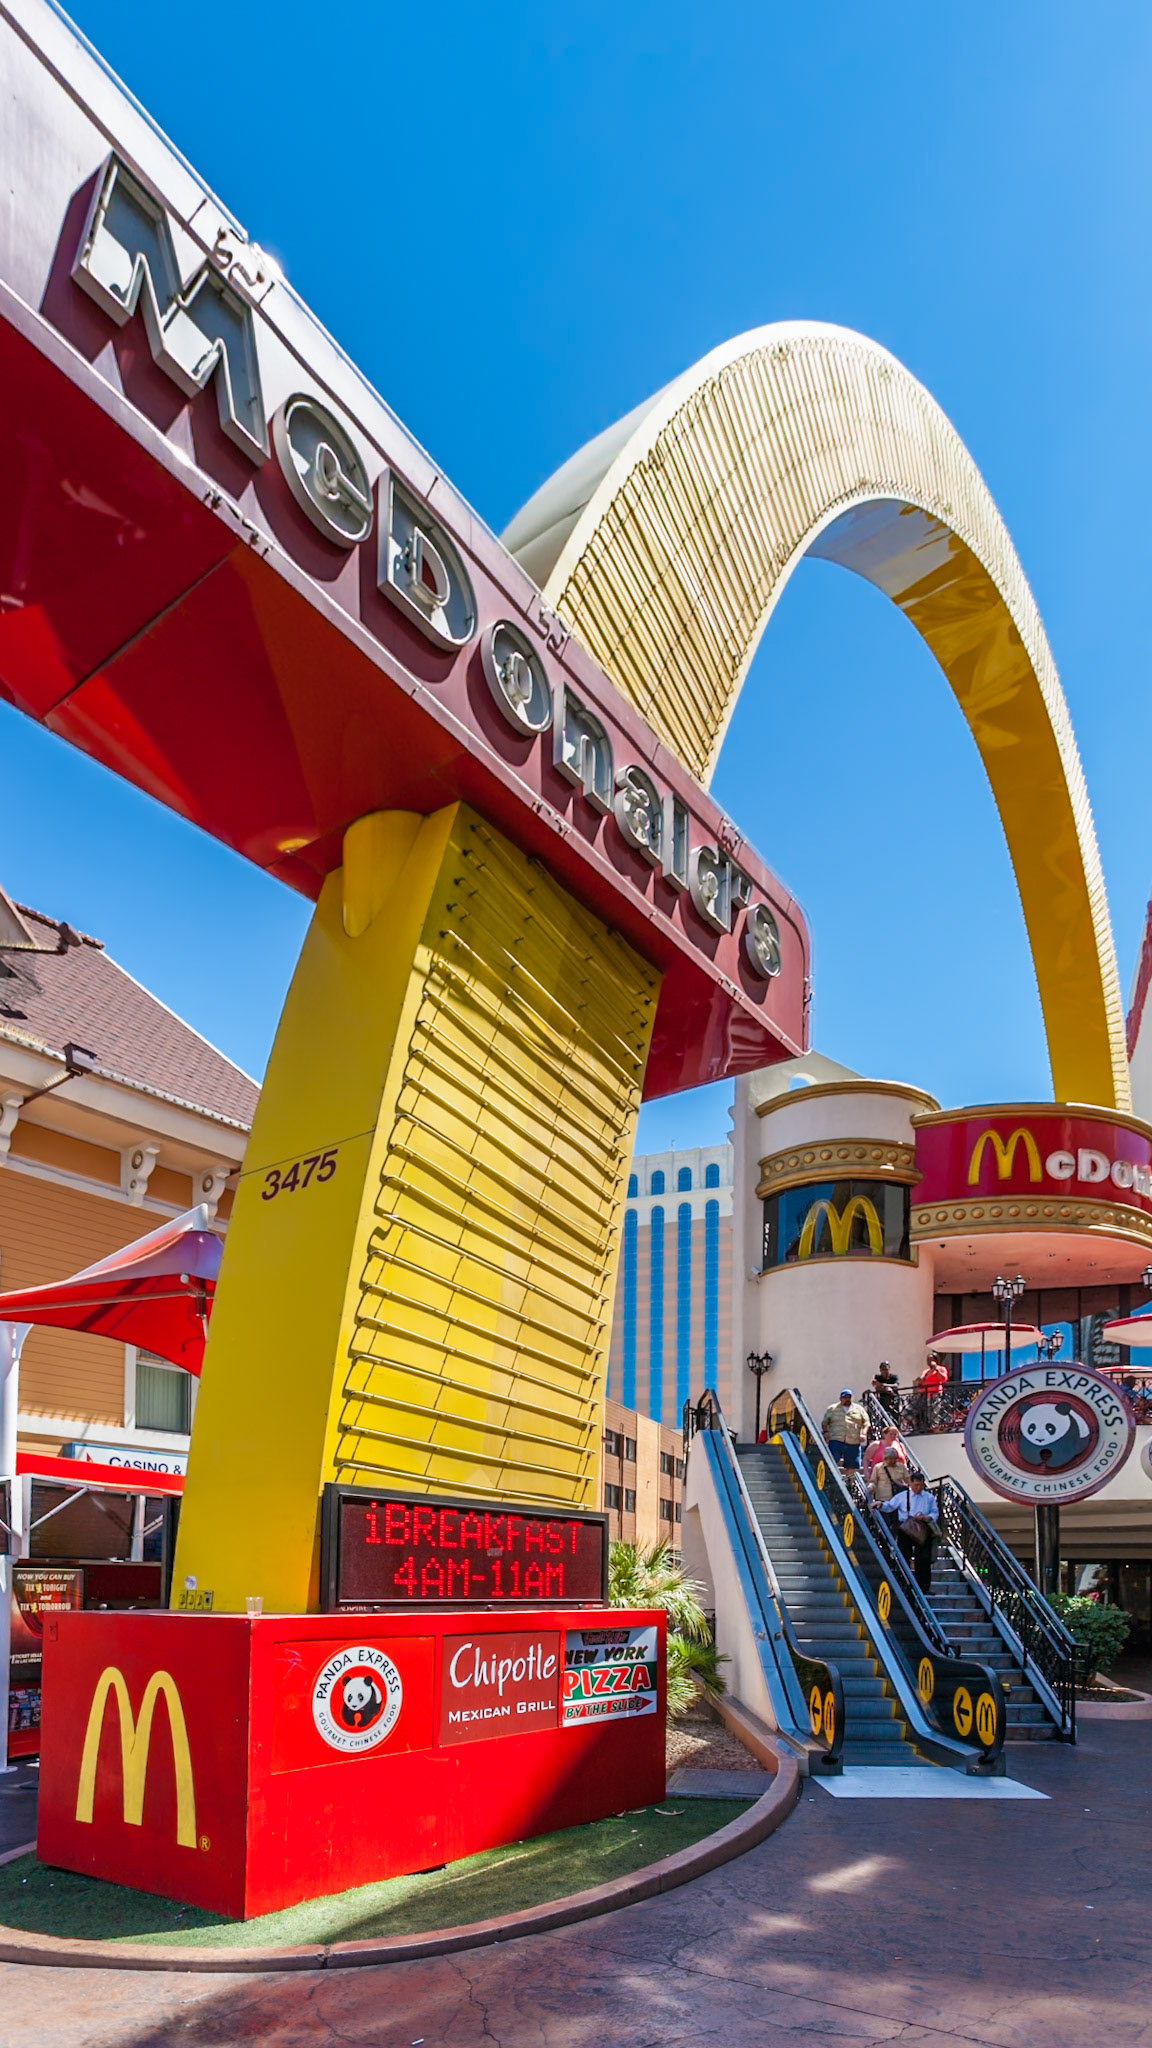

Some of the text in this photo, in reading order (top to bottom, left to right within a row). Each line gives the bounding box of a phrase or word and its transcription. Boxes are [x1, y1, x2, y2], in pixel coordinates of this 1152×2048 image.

[71, 149, 782, 982] McDonald's
[261, 1148, 339, 1201] 3475
[975, 1371, 1124, 1432] PANDA EXPRESS
[109, 1456, 169, 1474] CASINO
[980, 1441, 1118, 1492] GOURMET CHINESE FOOD
[393, 1556, 565, 1597] 4AM-11AM
[316, 1649, 400, 1699] PANDA EXPRESS
[449, 1642, 557, 1697] Chipotle
[565, 1645, 648, 1664] NEW YORK
[563, 1664, 652, 1700] PIZZA
[318, 1703, 397, 1747] GOURMET CHINESE FOOD
[448, 1700, 556, 1724] MEXICAN GRILL
[566, 1698, 643, 1718] BY THE SLICE
